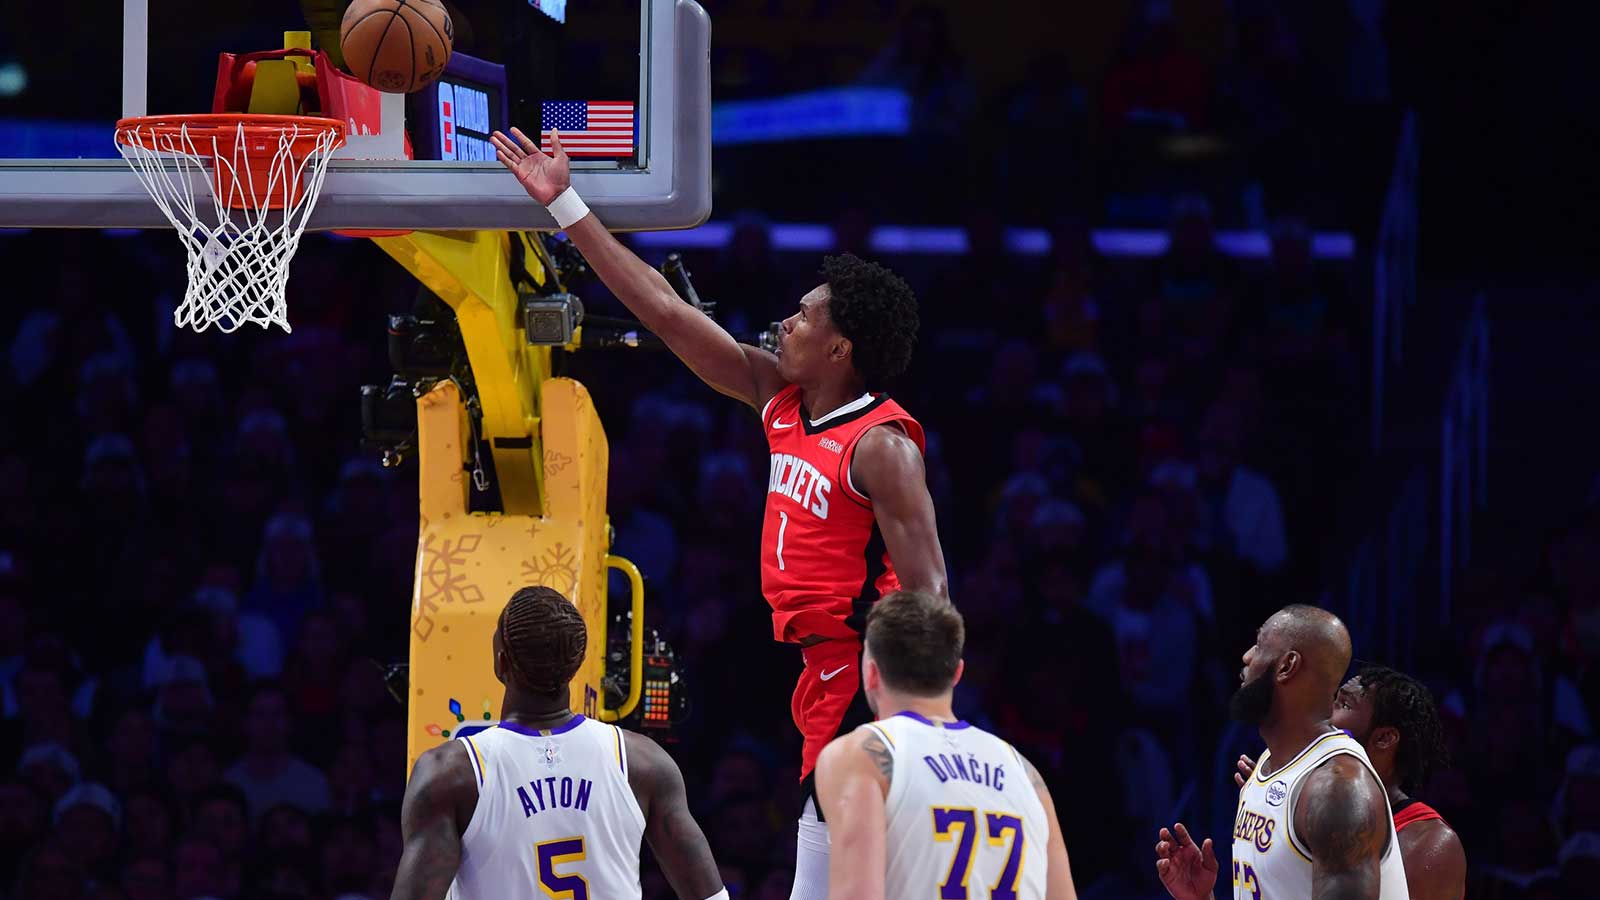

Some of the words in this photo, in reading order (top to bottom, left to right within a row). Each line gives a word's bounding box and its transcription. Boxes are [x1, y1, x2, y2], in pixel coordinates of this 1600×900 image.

[777, 511, 788, 571] 1
[517, 776, 593, 818] AYTON
[924, 752, 1005, 791] DONČIĆ
[930, 805, 1027, 900] 77
[1233, 800, 1276, 853] AKERS
[534, 836, 590, 900] 5
